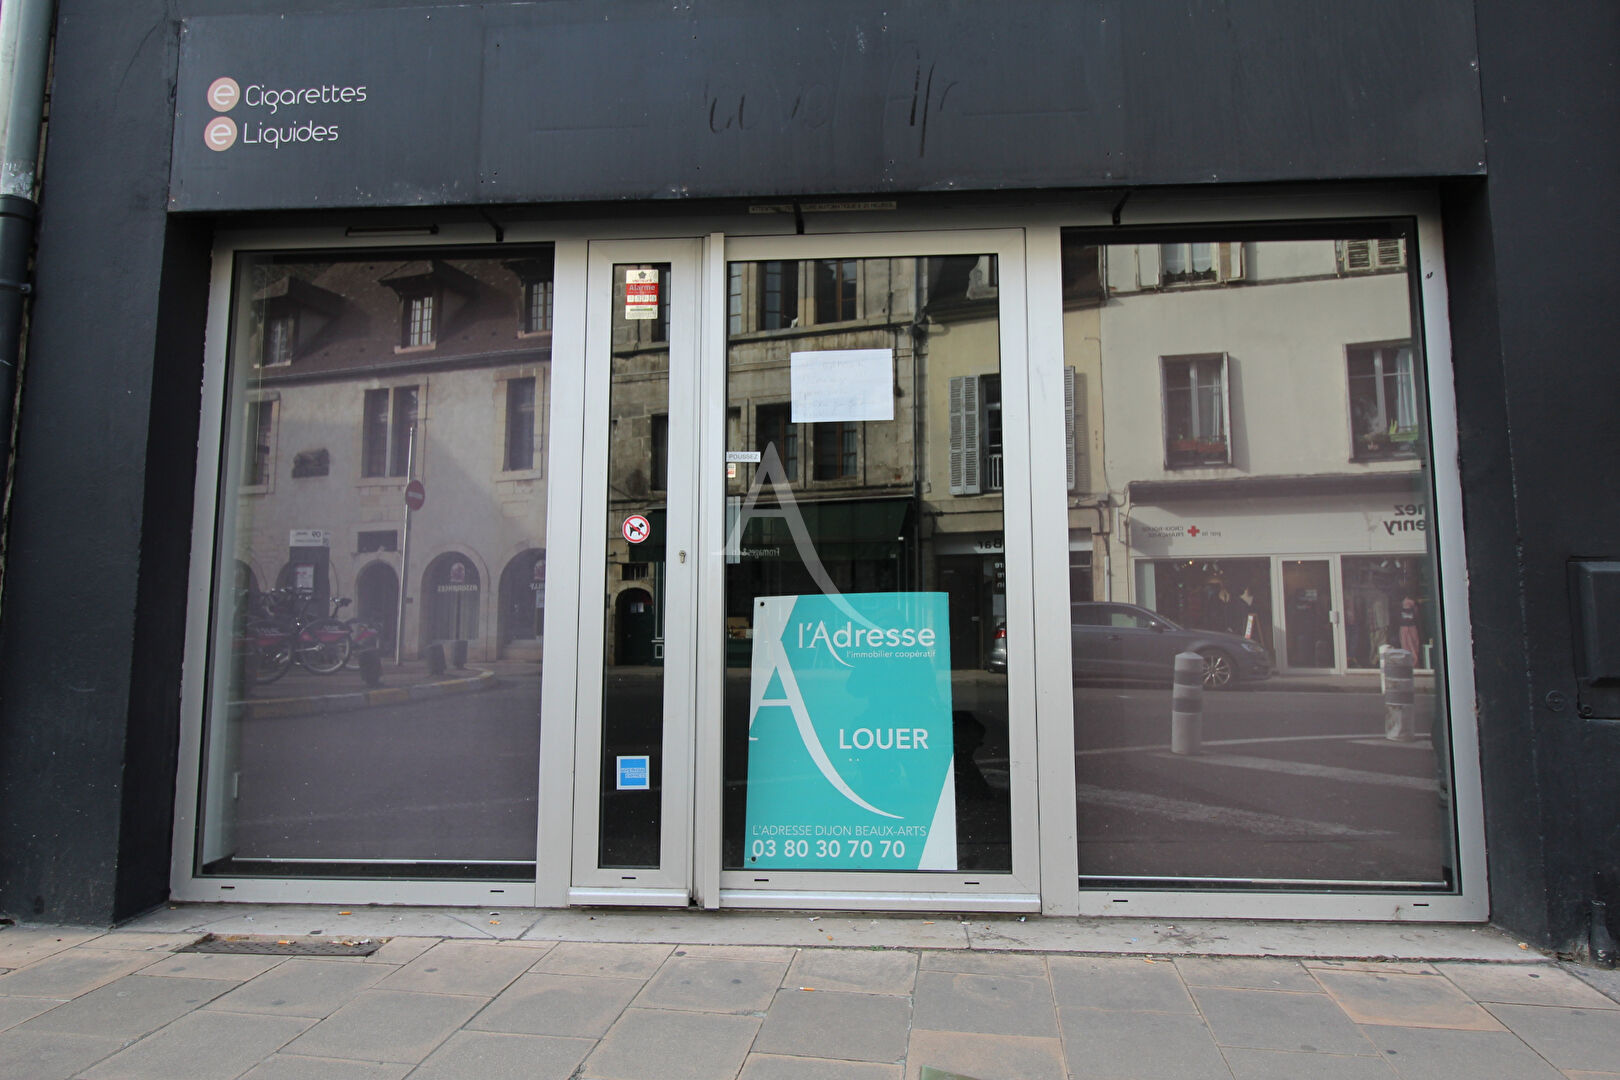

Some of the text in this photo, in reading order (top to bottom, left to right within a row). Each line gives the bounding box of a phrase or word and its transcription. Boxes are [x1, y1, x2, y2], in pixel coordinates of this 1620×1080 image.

[245, 84, 367, 115] Cigarettes
[243, 120, 338, 149] Liquides
[798, 620, 936, 668] l'Adresse
[846, 649, 936, 660] l'immobilier coopératif
[839, 728, 929, 750] LOUER
[752, 825, 927, 837] L'ADRESSE DIJON BEAUX-ARTS
[752, 839, 906, 859] 03 80 30 70 70
